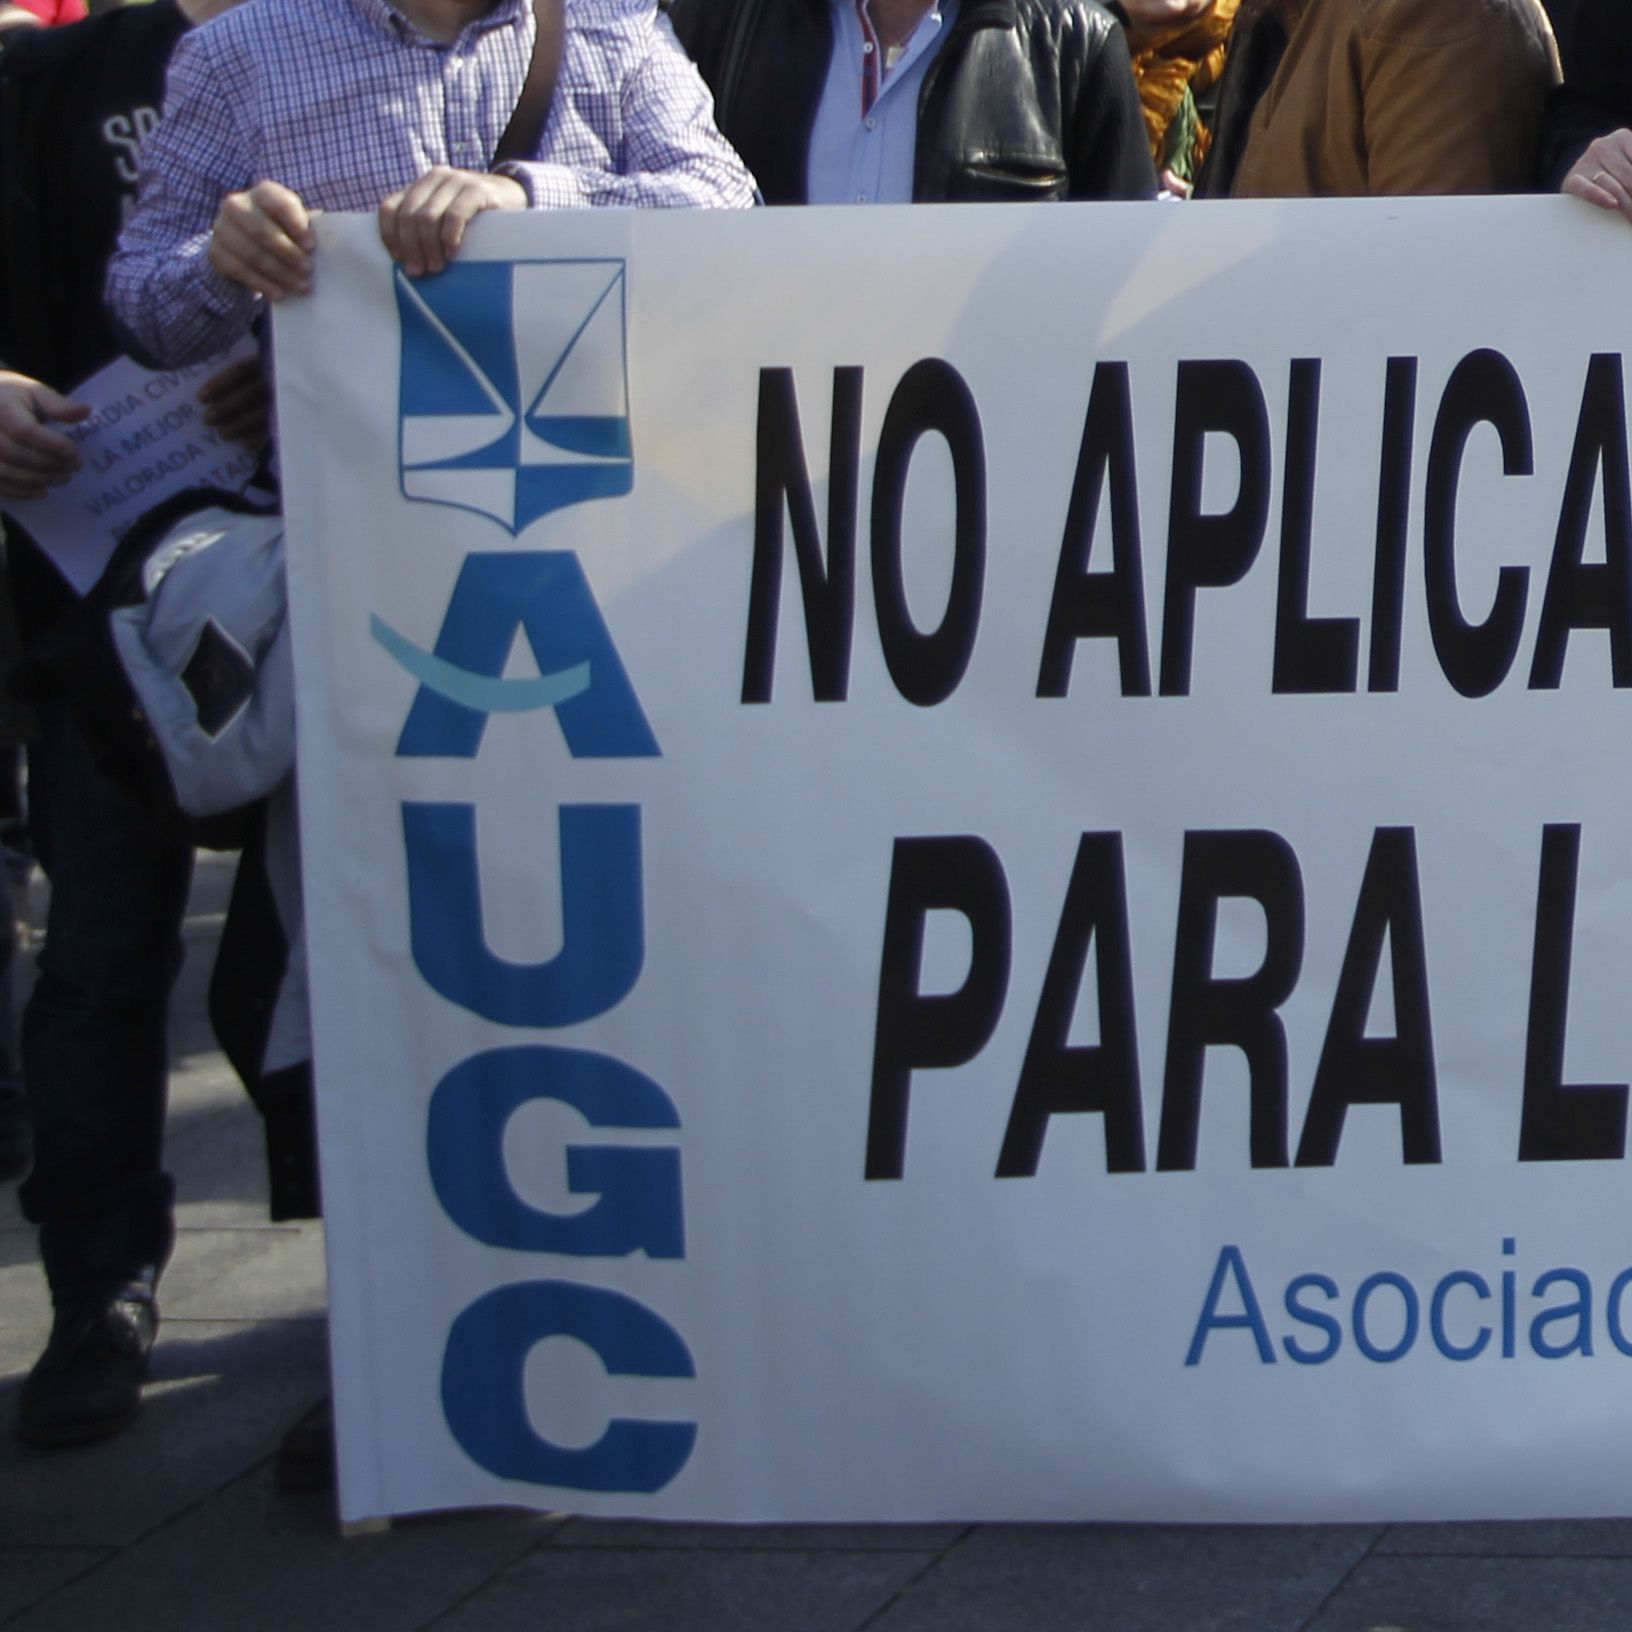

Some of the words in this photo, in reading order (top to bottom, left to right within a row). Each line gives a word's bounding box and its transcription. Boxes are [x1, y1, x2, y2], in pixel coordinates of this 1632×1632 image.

[741, 359, 985, 706] NO
[372, 551, 698, 1493] AUGC
[865, 827, 1441, 1180] PARA
